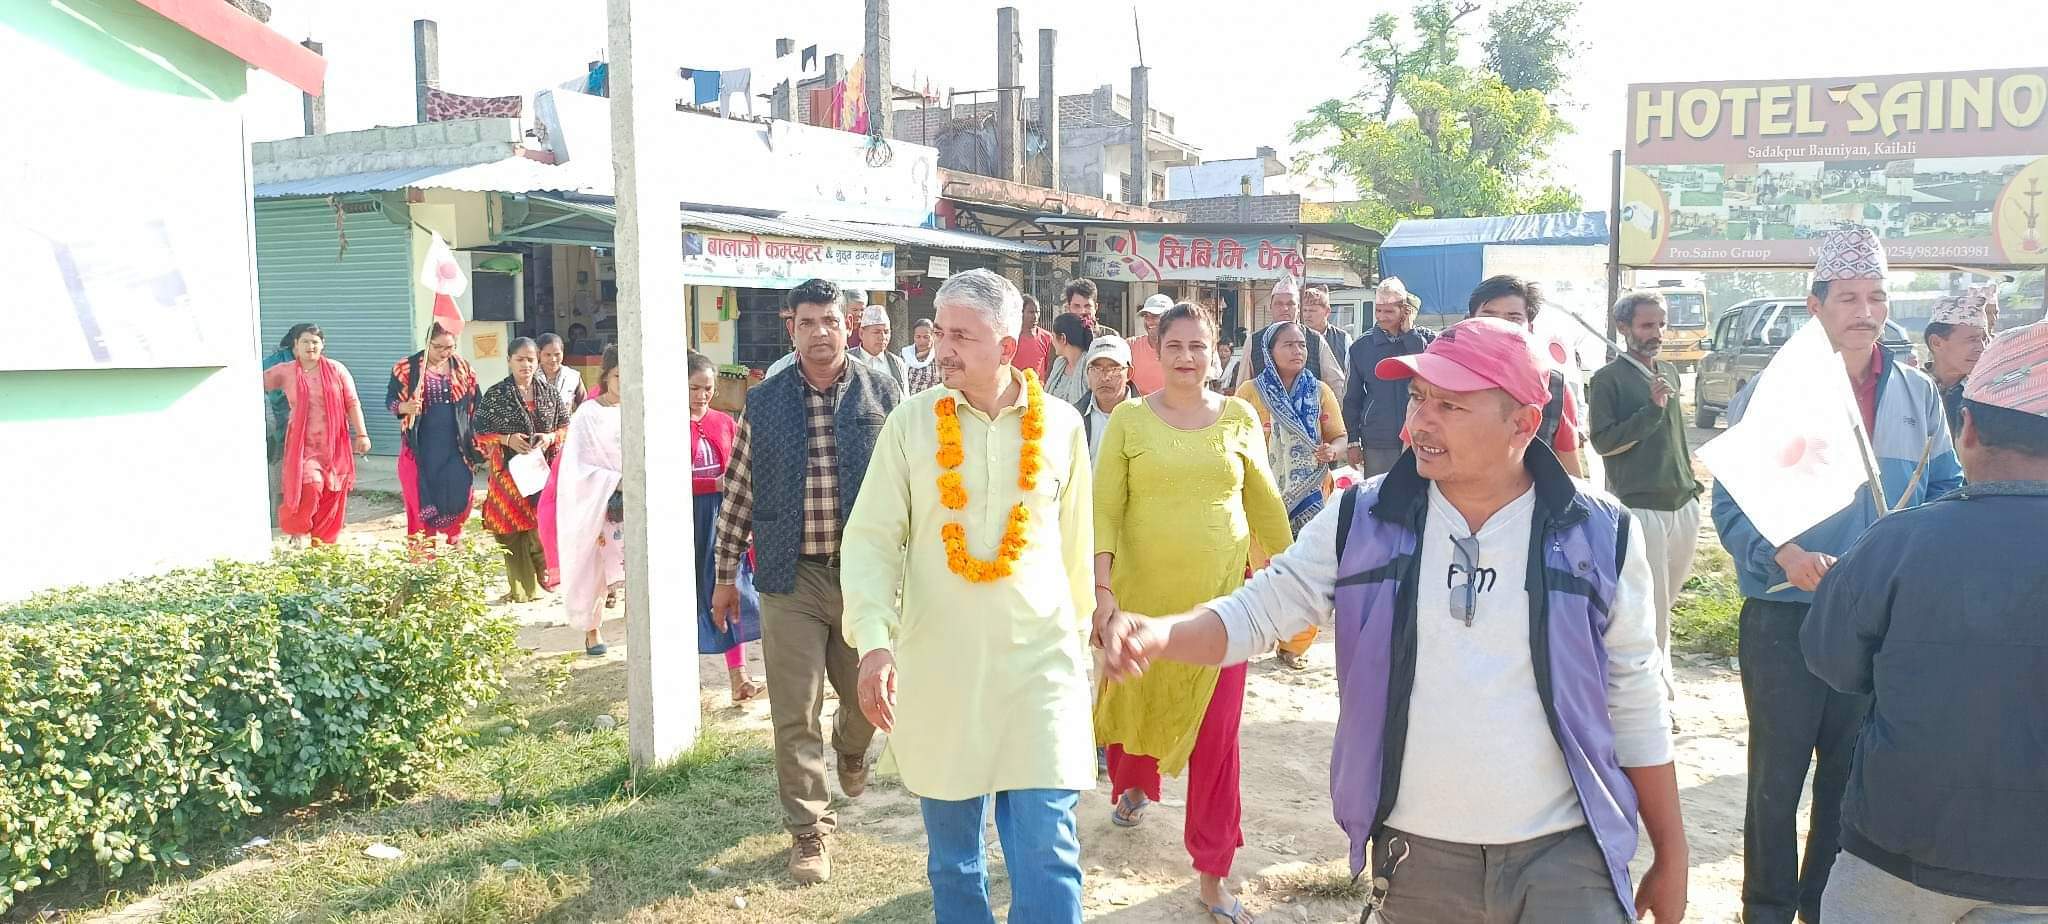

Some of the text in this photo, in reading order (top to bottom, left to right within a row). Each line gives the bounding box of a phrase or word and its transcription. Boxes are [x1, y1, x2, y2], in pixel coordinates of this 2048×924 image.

[1635, 73, 2048, 145] HOTEL SAINO
[1748, 142, 1917, 160] Sadakpur Bauniyan, Kailali
[707, 234, 761, 259] बालाजी
[825, 246, 834, 258] &
[1730, 247, 1771, 261] Gruop
